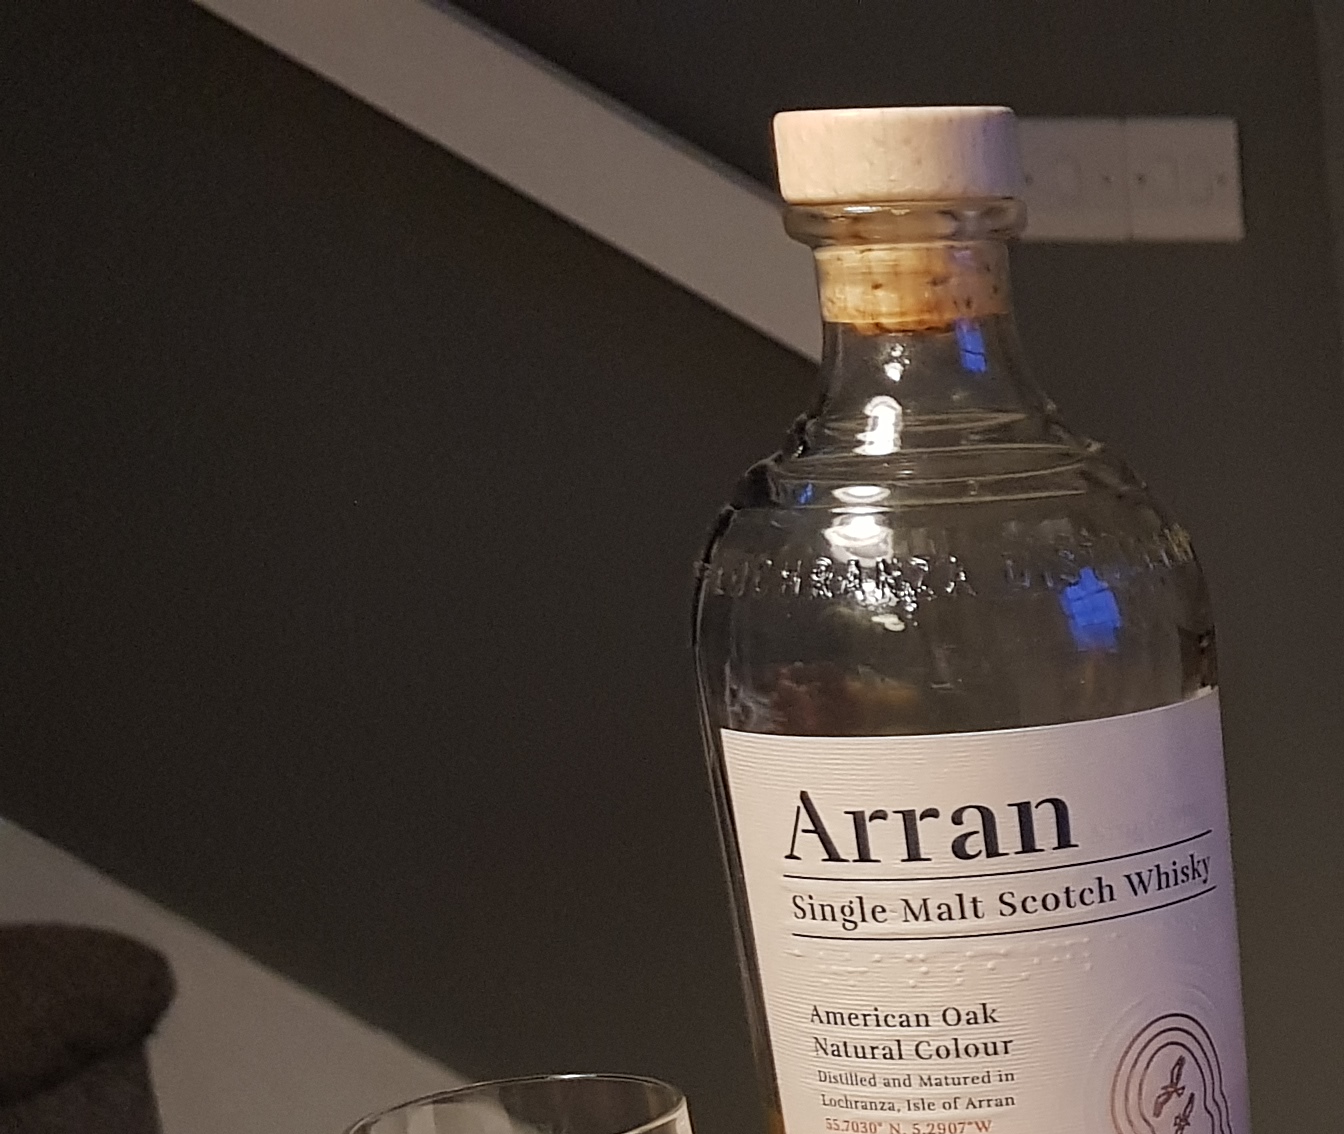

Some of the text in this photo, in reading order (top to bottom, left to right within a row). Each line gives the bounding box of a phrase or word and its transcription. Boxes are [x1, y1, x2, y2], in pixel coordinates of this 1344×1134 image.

[784, 790, 1079, 863] Arran
[791, 852, 1212, 930] Single Malt Scotch Whisky
[810, 1003, 1000, 1028] American Oak
[813, 1036, 1014, 1060] Natural Colour
[817, 1069, 1015, 1088] Distilled and Matured in
[821, 1093, 1016, 1113] Lochranza, Isle of Arran
